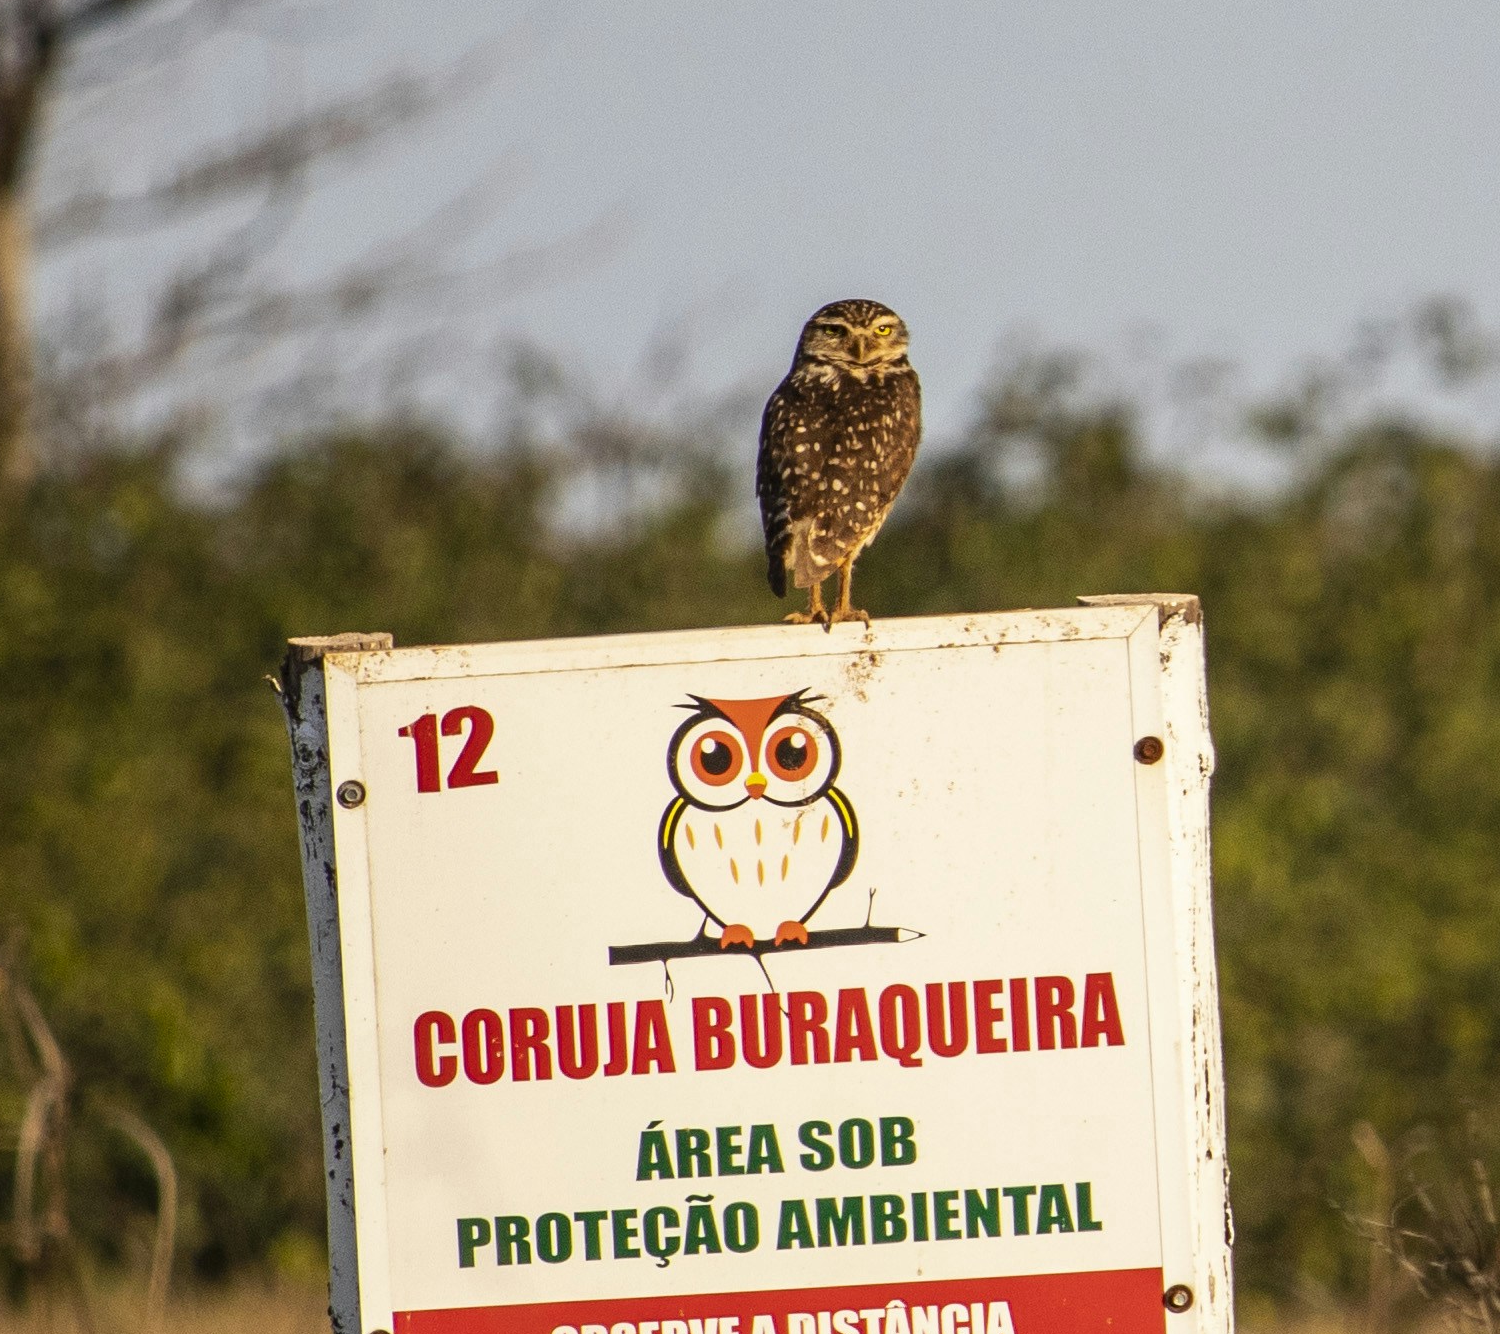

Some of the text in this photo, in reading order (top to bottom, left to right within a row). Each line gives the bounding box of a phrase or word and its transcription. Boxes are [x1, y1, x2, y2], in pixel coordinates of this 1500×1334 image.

[398, 706, 498, 793] 12
[414, 972, 1125, 1088] CORUJA BURAQUEIRA
[635, 1116, 917, 1181] ÁREA SOB
[457, 1182, 1102, 1268] PROTEÇÃO AMBIENTAL
